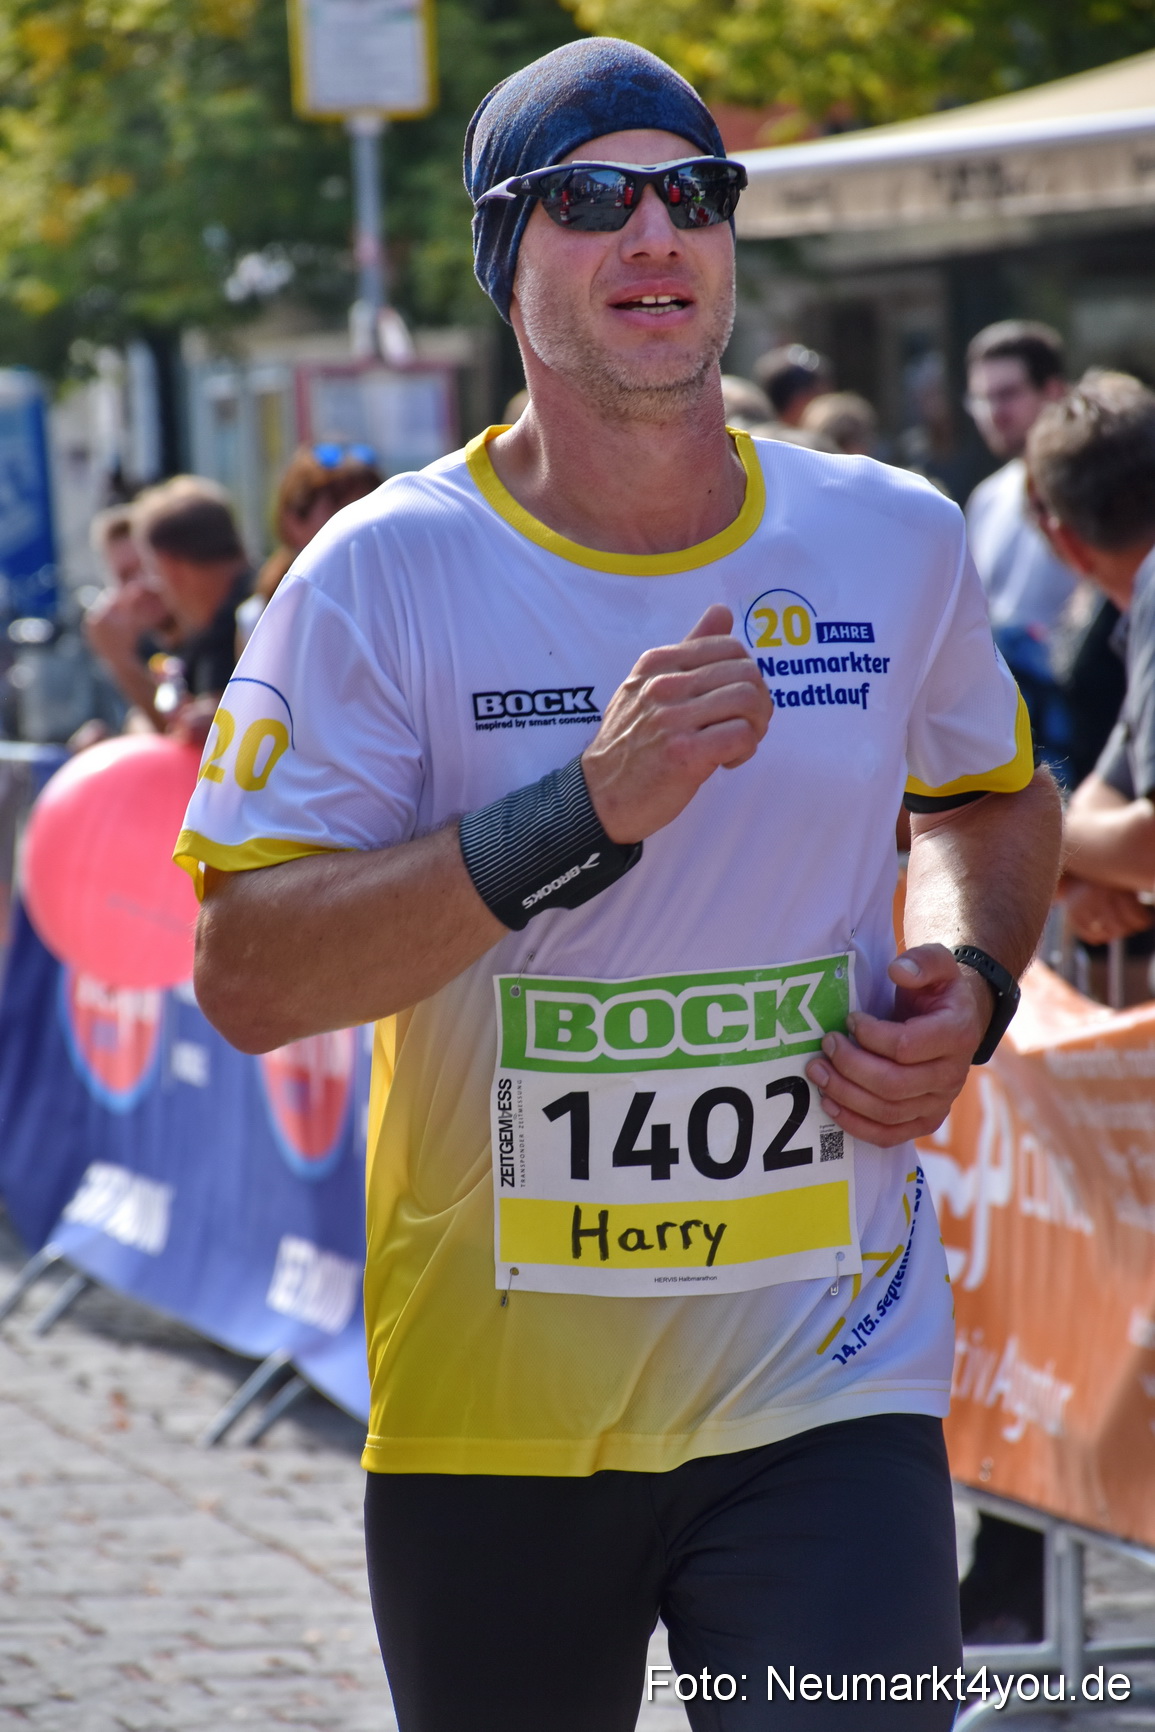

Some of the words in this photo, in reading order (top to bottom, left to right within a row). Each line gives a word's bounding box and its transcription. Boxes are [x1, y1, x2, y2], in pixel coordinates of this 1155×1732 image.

[753, 605, 811, 648] 20
[822, 625, 870, 641] JAHRE
[757, 651, 890, 679] Neumarkter
[473, 687, 599, 720] BOCK
[475, 718, 512, 732] inspired
[516, 719, 526, 729] by
[529, 717, 557, 727] smart
[559, 714, 602, 725] concepts
[198, 707, 289, 792] 20
[522, 865, 582, 909] BROOKS
[528, 975, 821, 1058] BOCK
[541, 1075, 814, 1181] 1402
[571, 1205, 728, 1267] Harry
[679, 1275, 718, 1283] Halbmarathon
